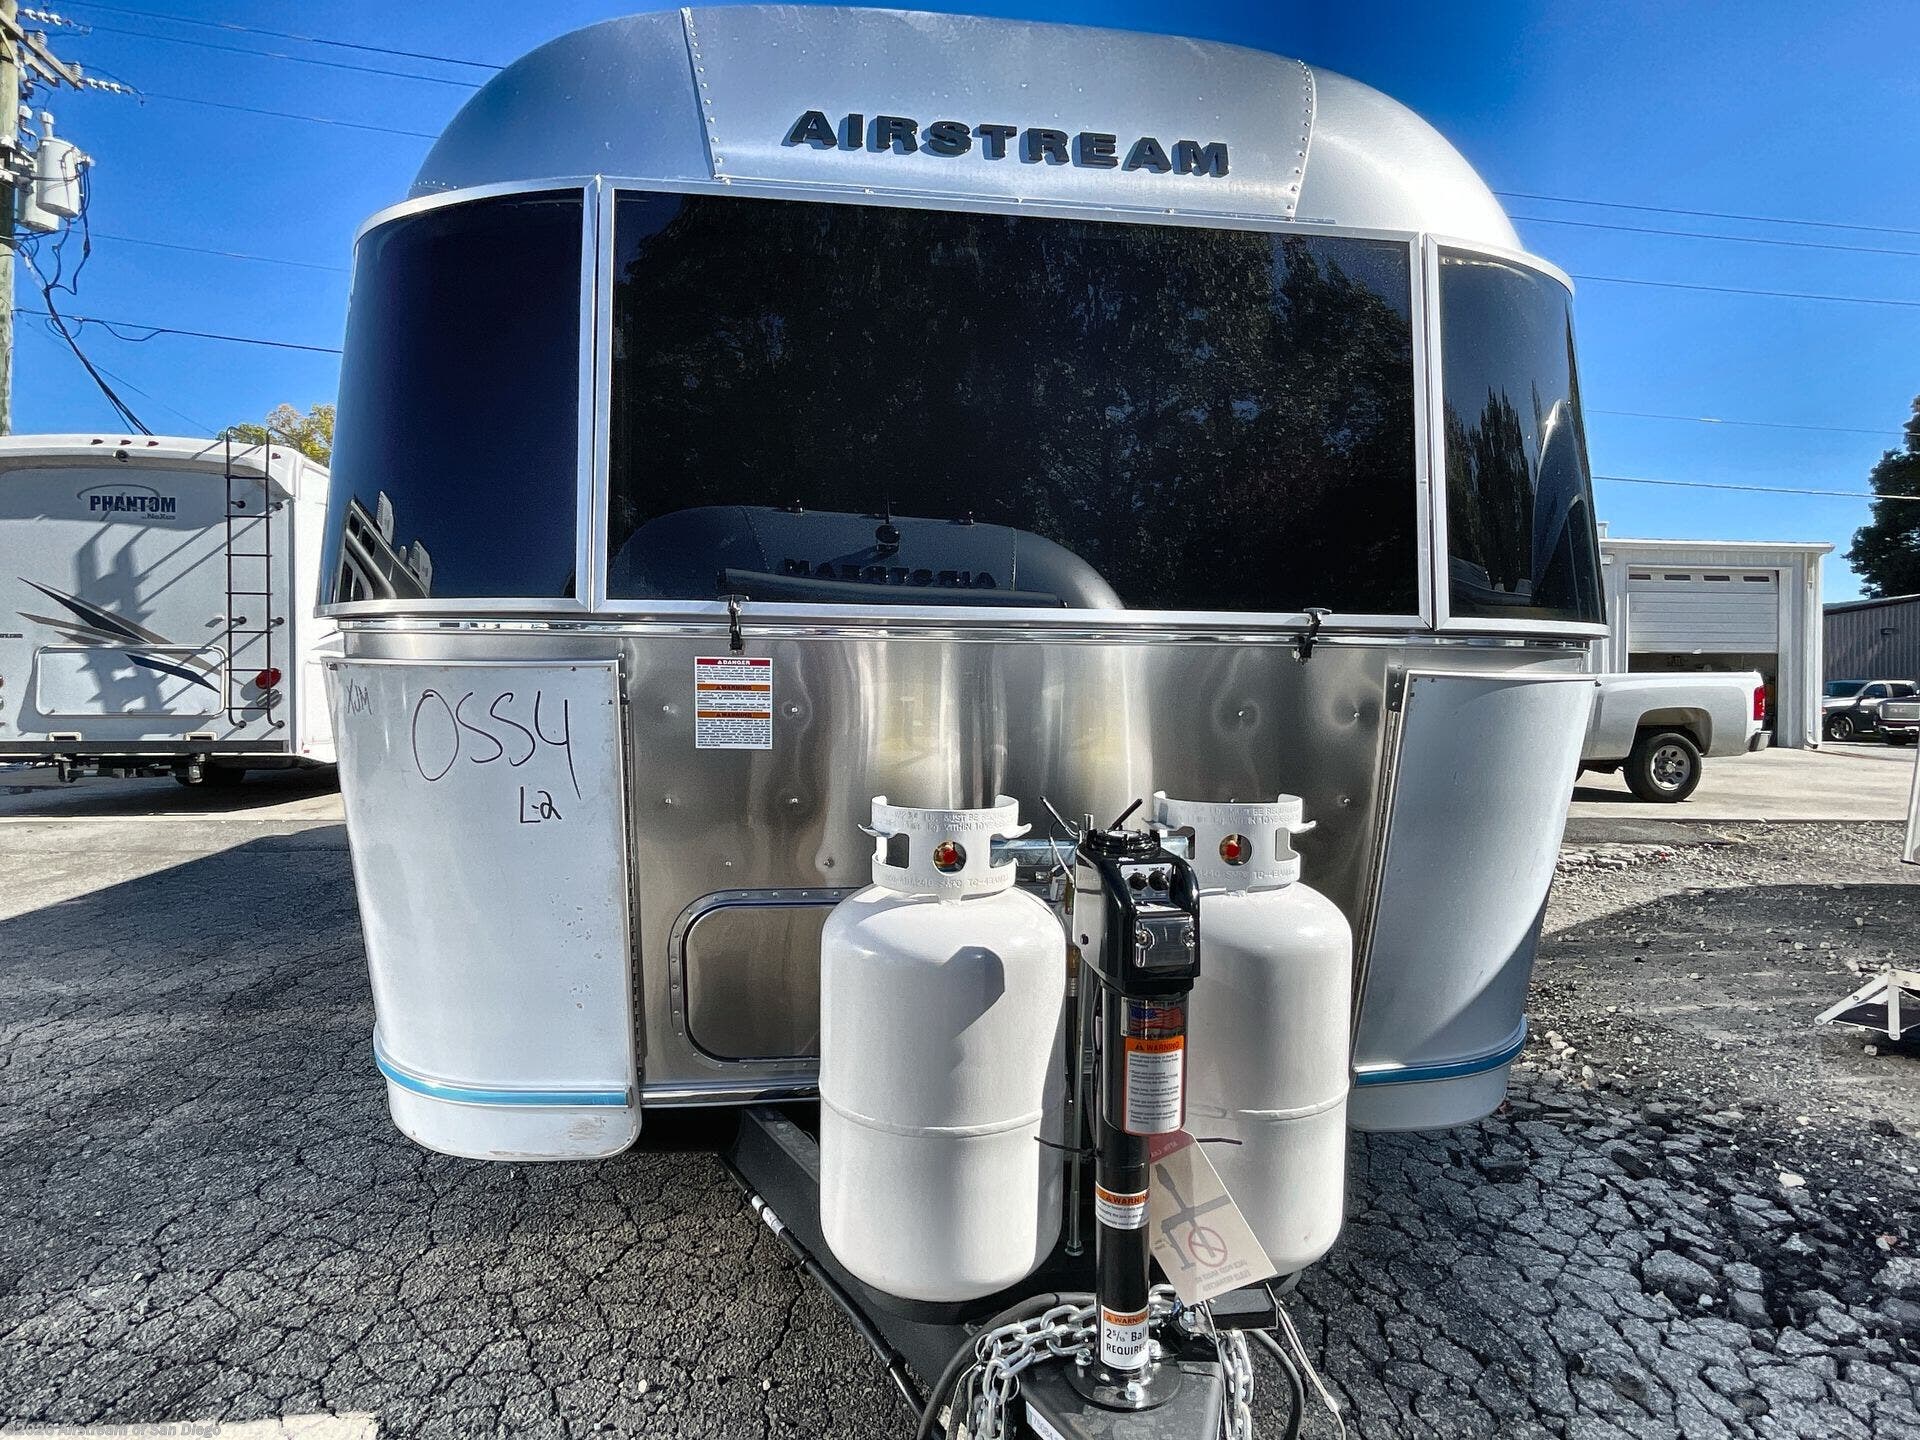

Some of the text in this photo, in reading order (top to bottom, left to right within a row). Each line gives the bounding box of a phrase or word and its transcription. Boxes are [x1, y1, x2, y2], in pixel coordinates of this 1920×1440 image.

[784, 110, 1229, 178] AIRSTREAM
[90, 496, 176, 512] PHANTOM
[1131, 1326, 1147, 1341] Ball
